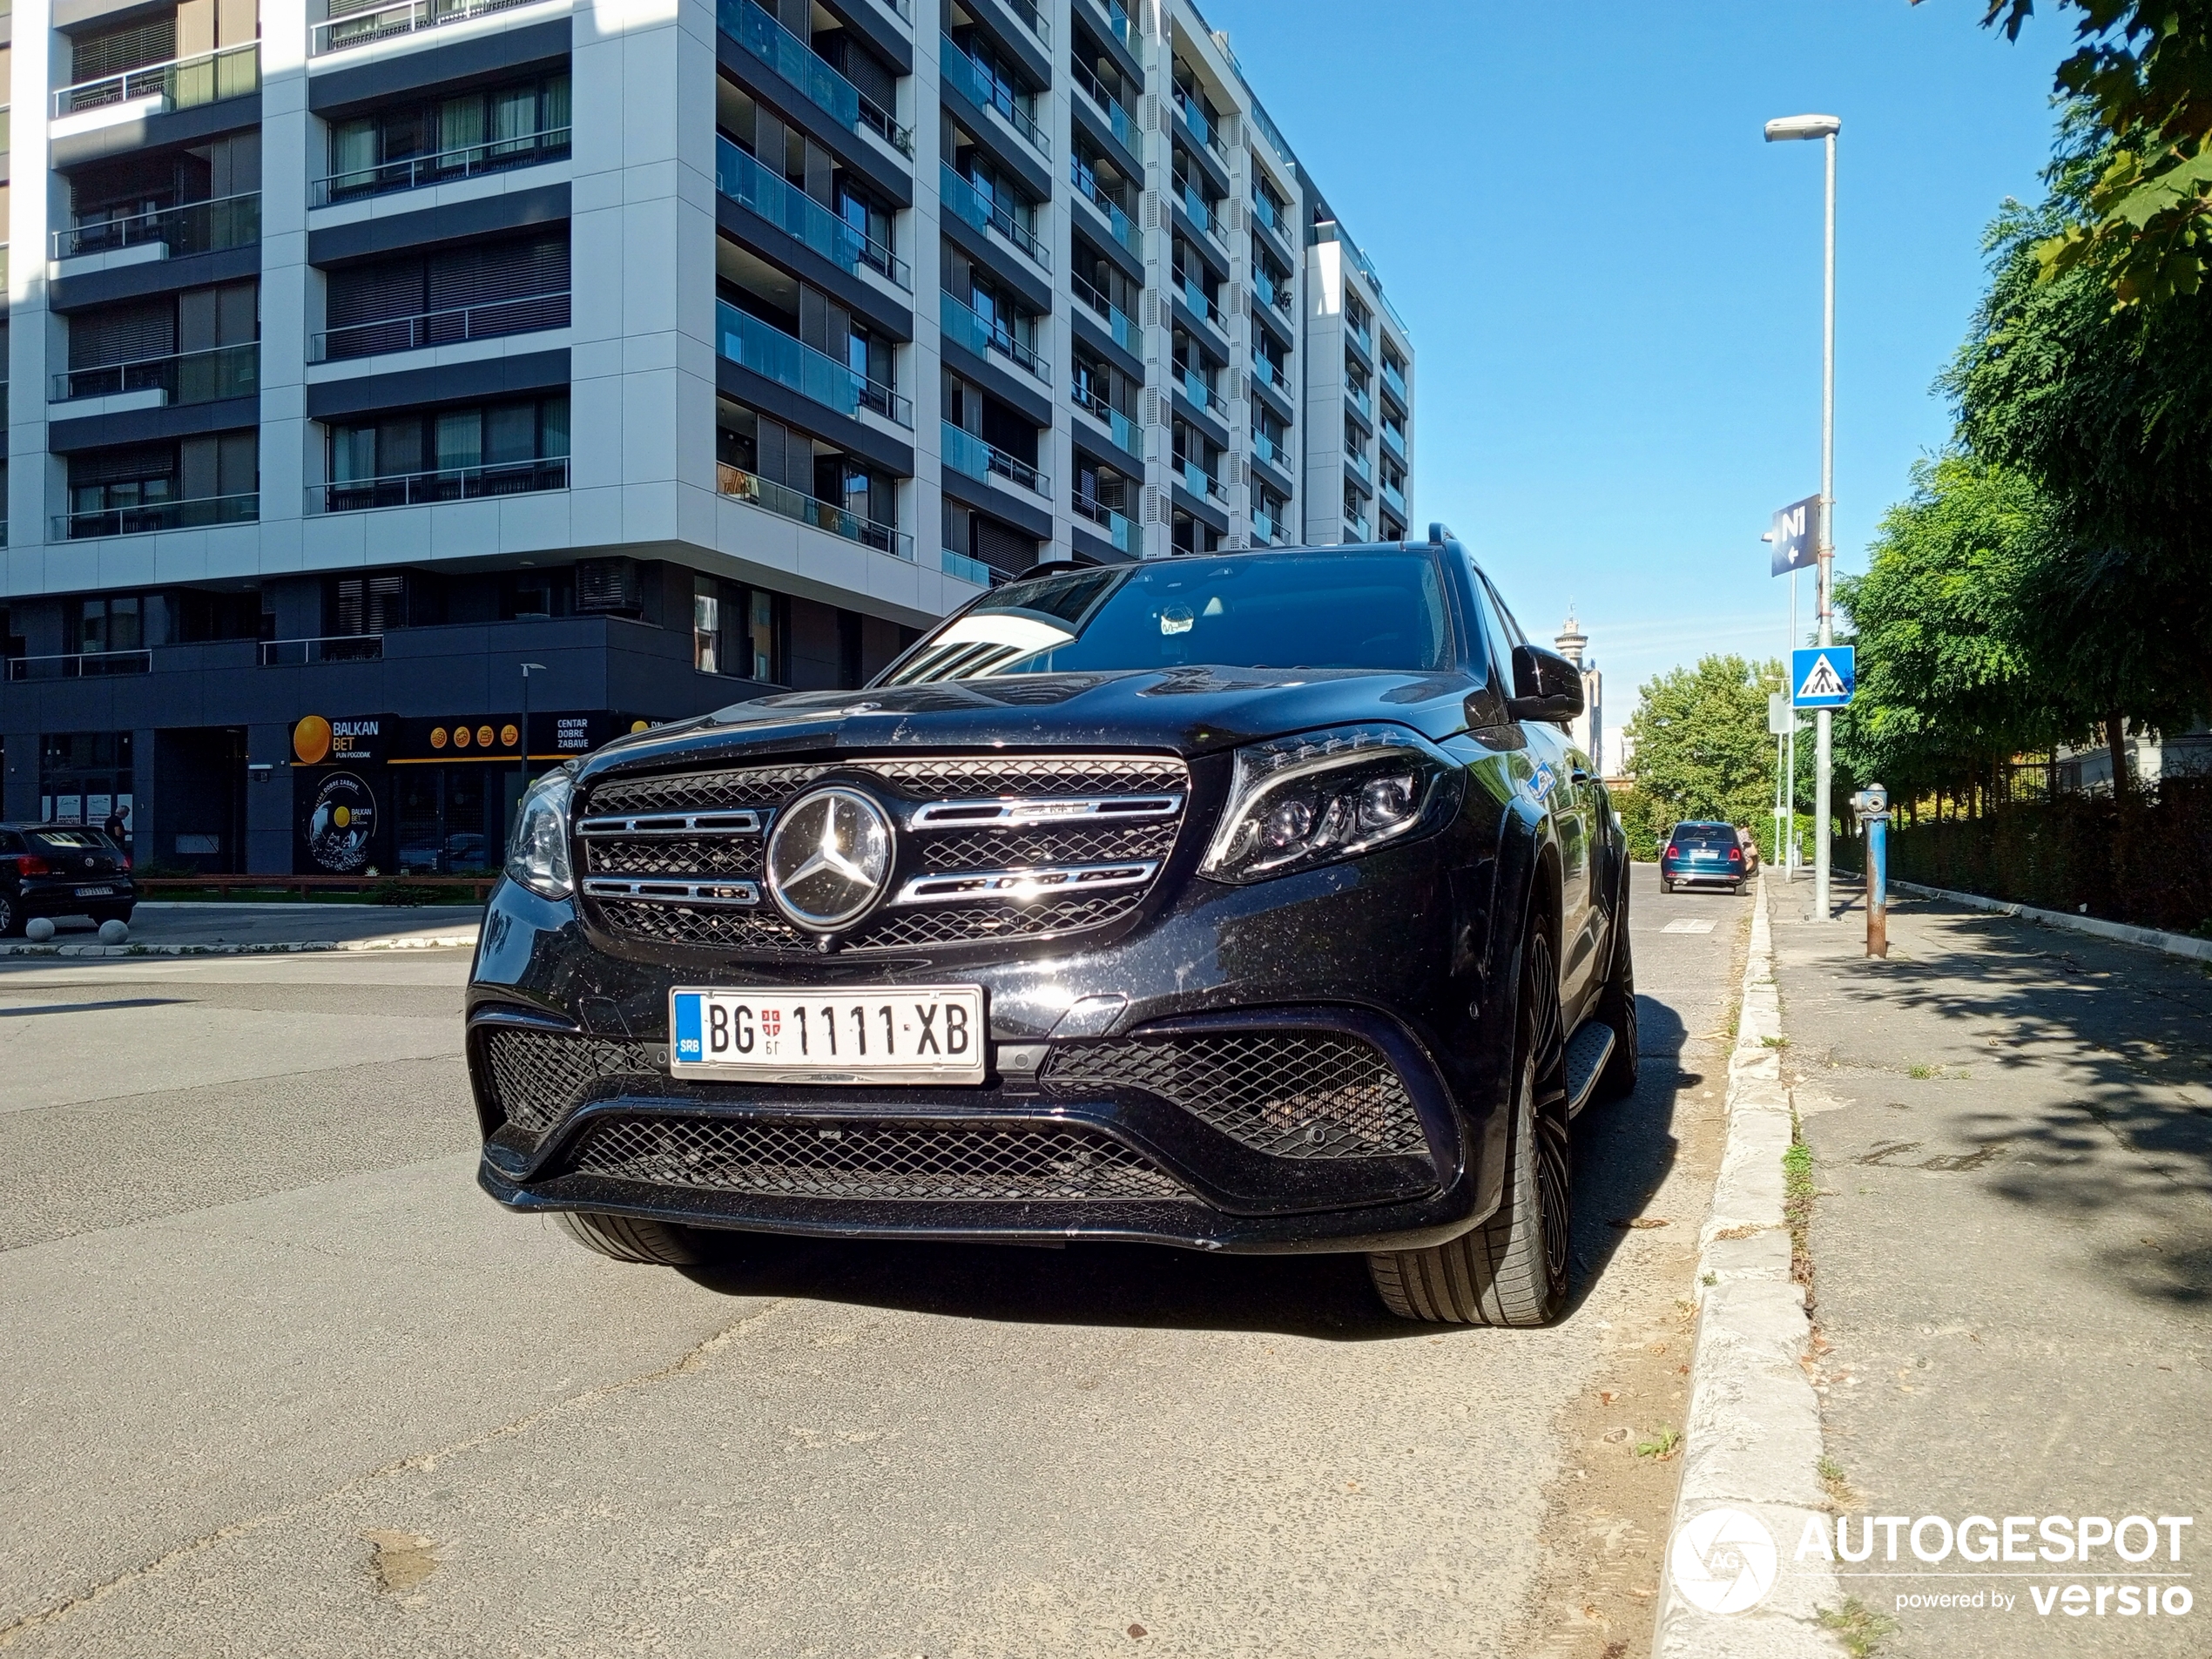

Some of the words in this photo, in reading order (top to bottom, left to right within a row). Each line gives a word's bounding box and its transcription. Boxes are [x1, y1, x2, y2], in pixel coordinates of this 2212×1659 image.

[334, 722, 378, 736] BALKAN
[557, 719, 588, 728] CENTAR
[558, 729, 584, 738] DOBRE
[333, 738, 354, 751] BET
[558, 739, 589, 748] ZABAVE
[323, 779, 340, 793] DOBRE
[340, 779, 359, 791] ZABAVE
[710, 1003, 755, 1055] BG
[680, 1039, 699, 1053] SRB
